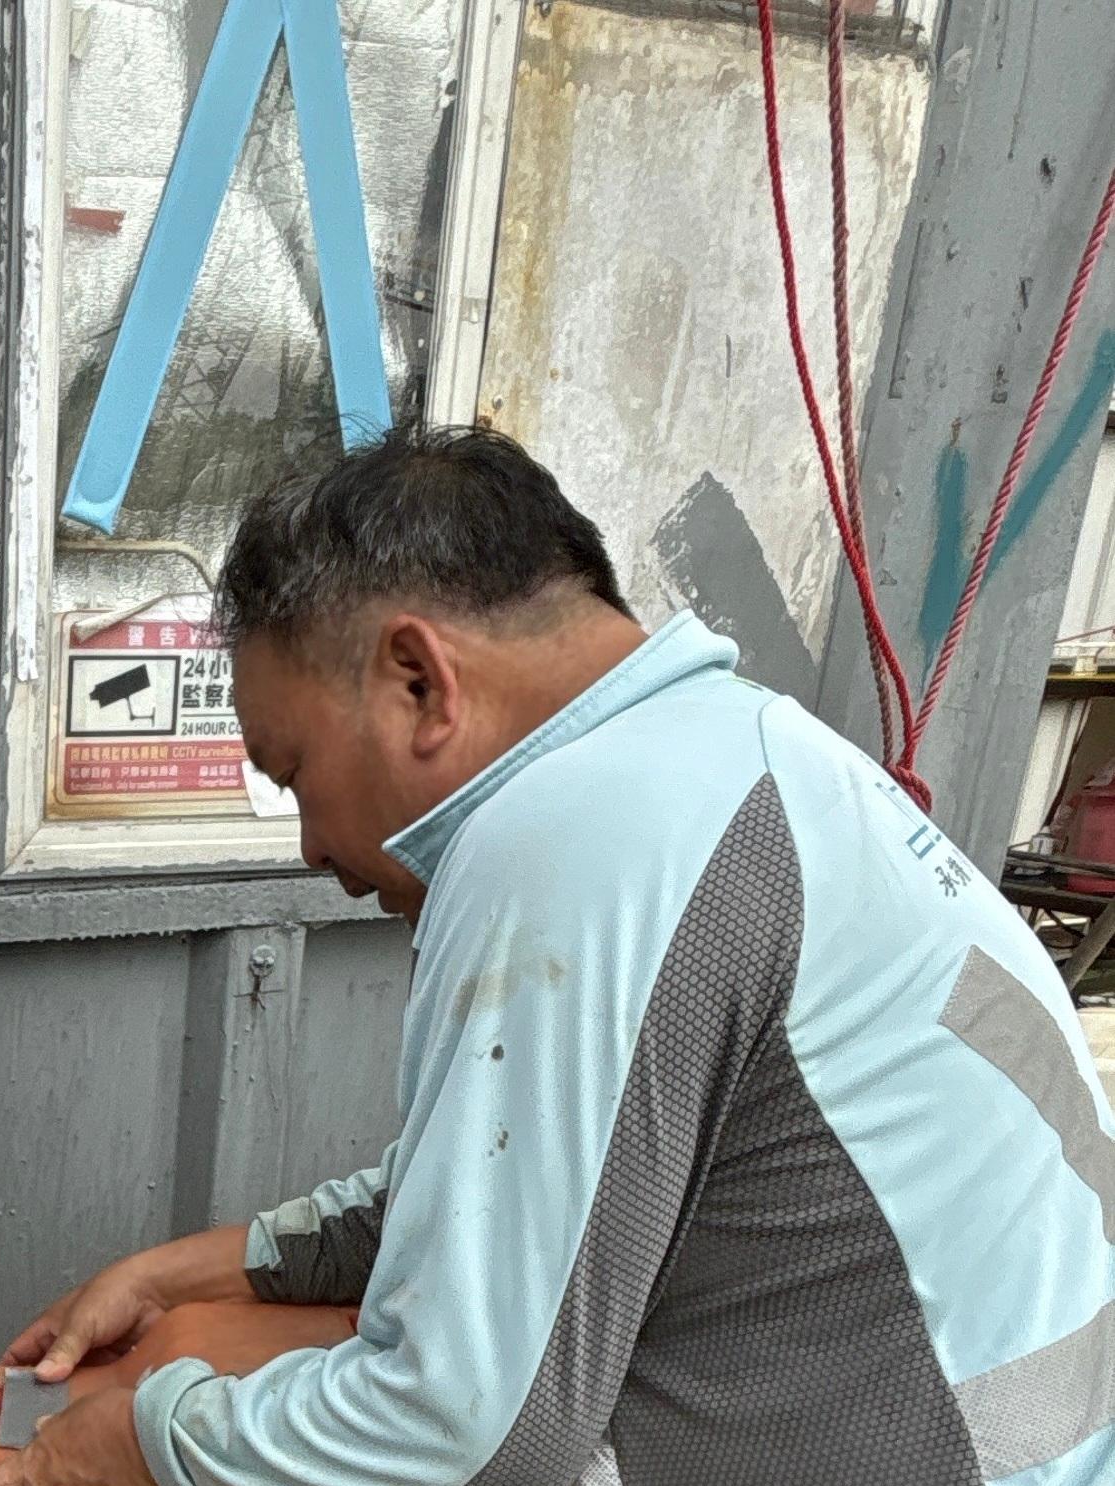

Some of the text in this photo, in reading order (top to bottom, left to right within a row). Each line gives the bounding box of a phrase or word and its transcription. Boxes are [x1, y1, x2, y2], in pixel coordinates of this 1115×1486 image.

[181, 722, 194, 736] 24
[195, 721, 226, 735] HOUR
[172, 746, 198, 758] CCTV
